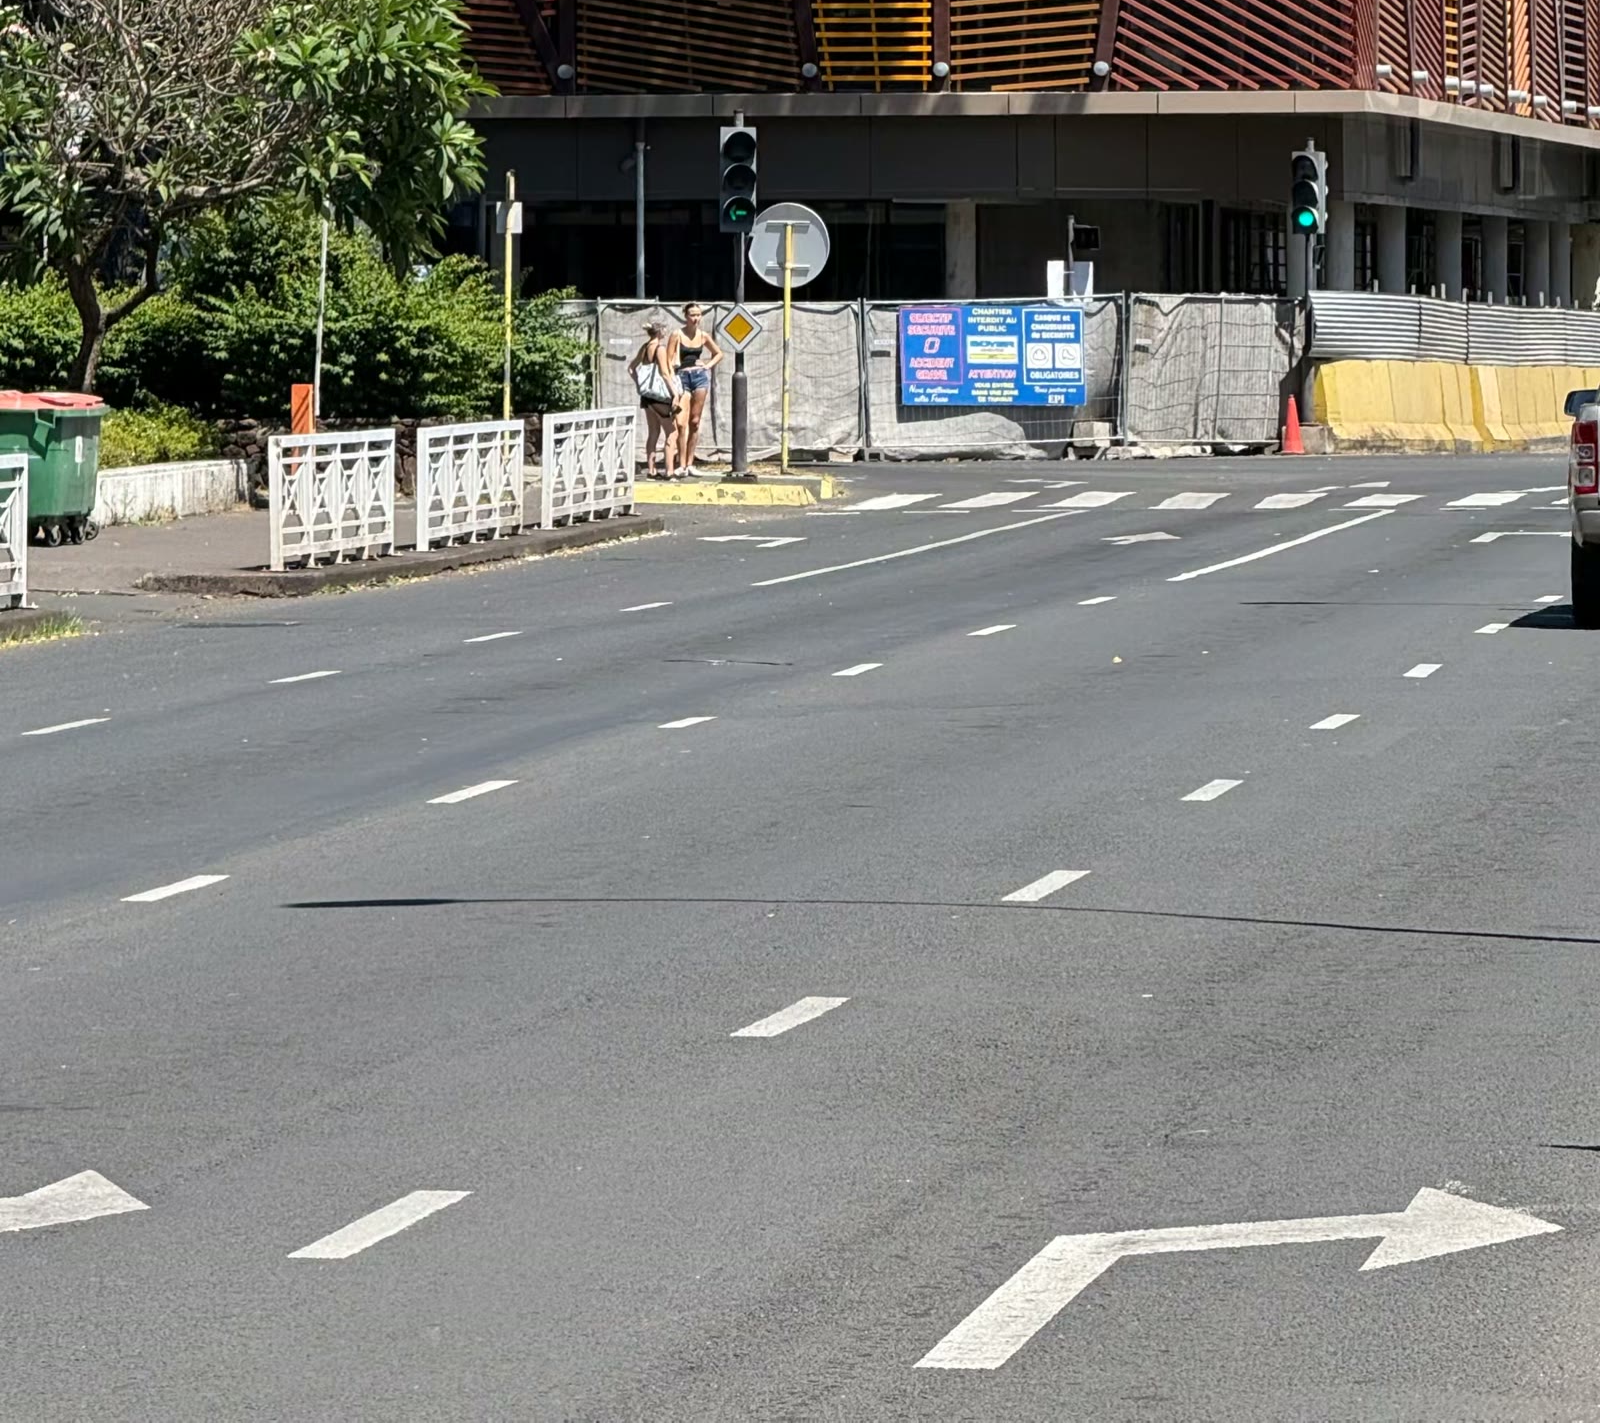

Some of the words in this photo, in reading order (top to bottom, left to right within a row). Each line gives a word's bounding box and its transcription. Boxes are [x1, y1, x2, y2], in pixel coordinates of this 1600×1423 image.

[909, 357, 955, 368] ACCIDENT
[968, 369, 1016, 379] ATTENTION
[1030, 371, 1079, 379] OBLIGATOIRES
[1048, 394, 1065, 404] EPI
